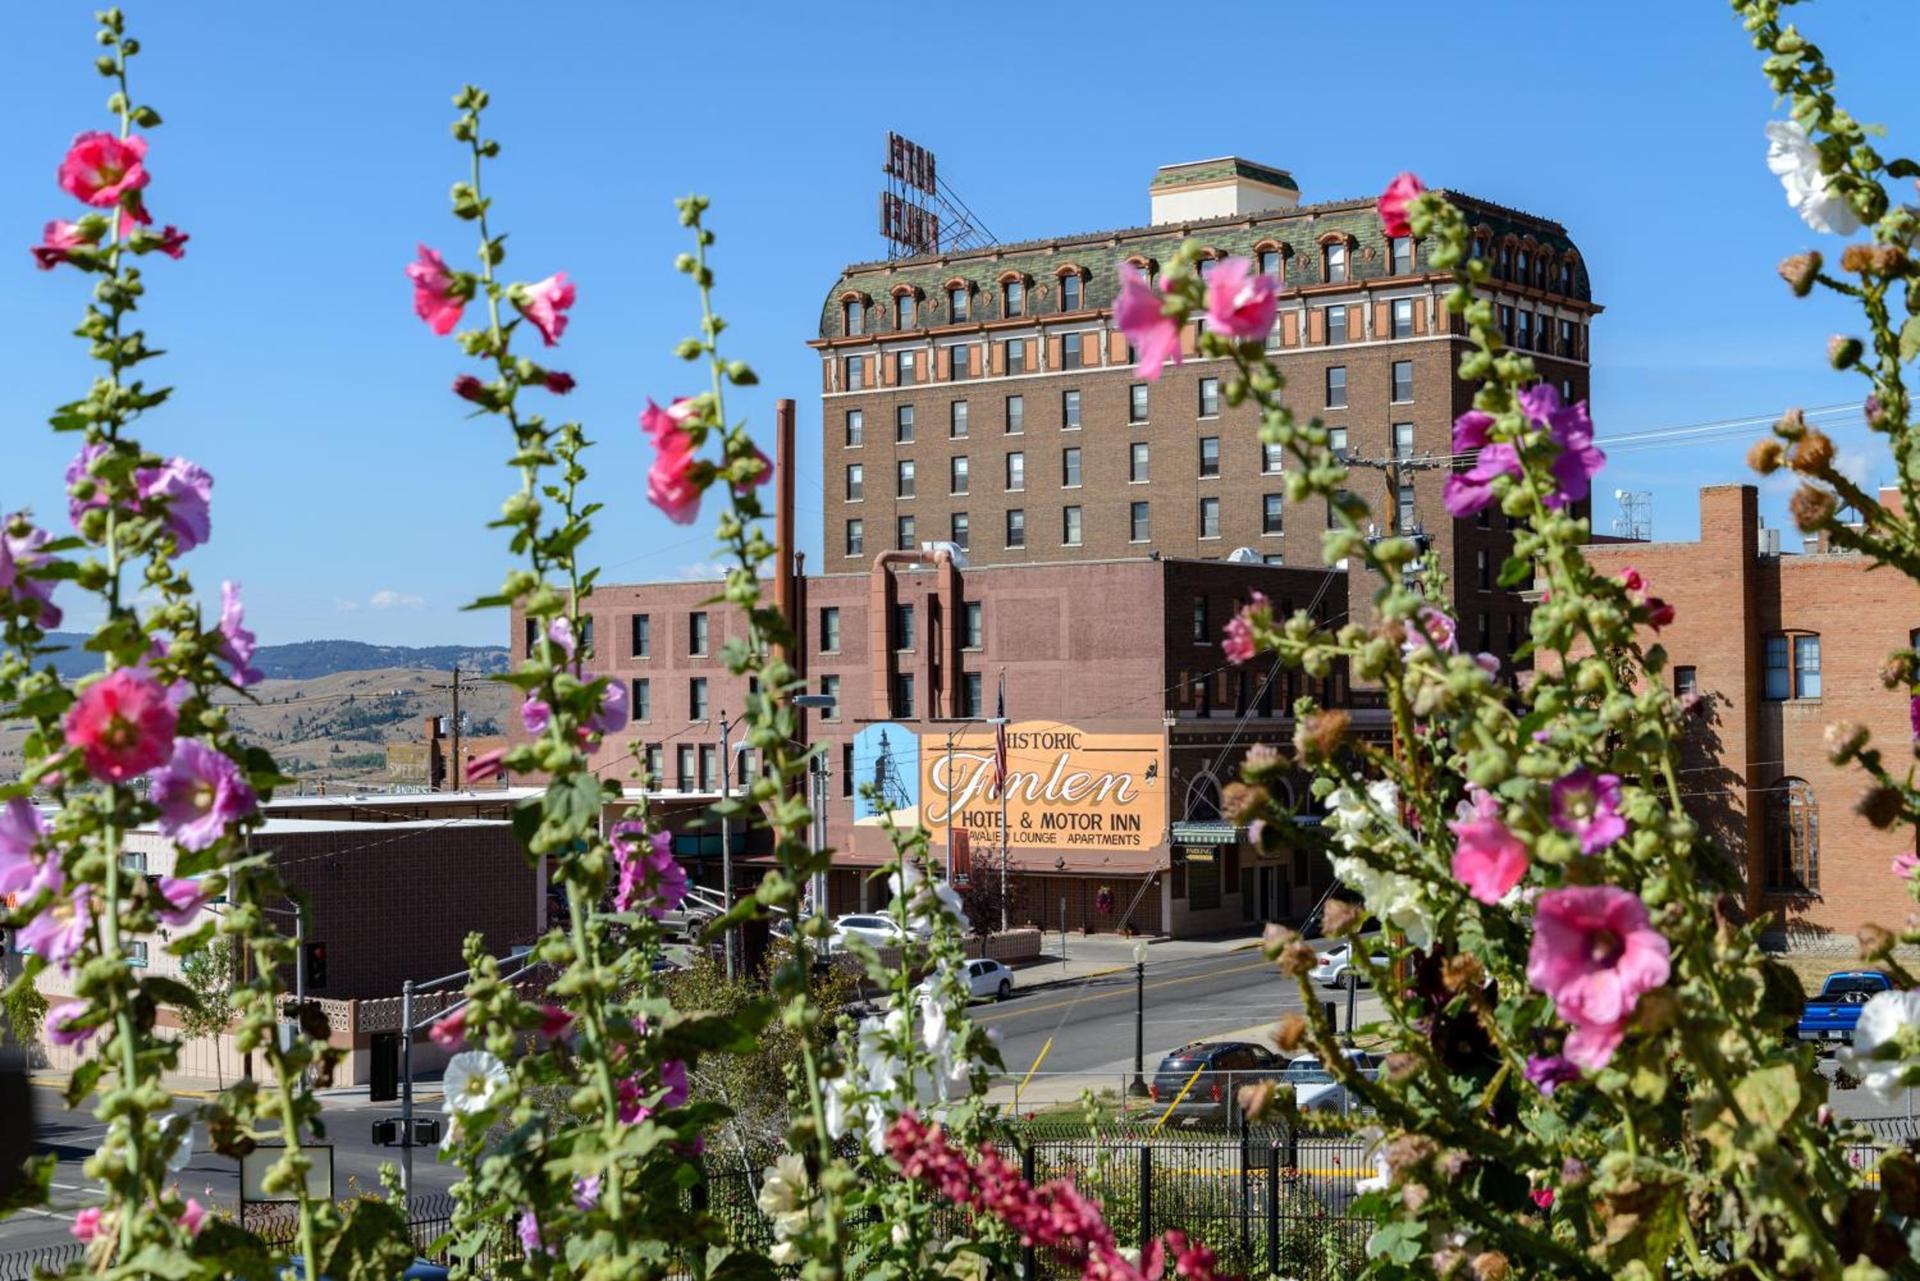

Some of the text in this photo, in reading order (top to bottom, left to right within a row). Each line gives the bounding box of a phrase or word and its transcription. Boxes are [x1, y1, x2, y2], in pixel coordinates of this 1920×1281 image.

[1020, 811, 1033, 829] &
[1040, 812, 1102, 830] MOTOR
[1111, 813, 1141, 831] INN
[968, 830, 1141, 846] AVALIE LOUNGE APARTMENTS
